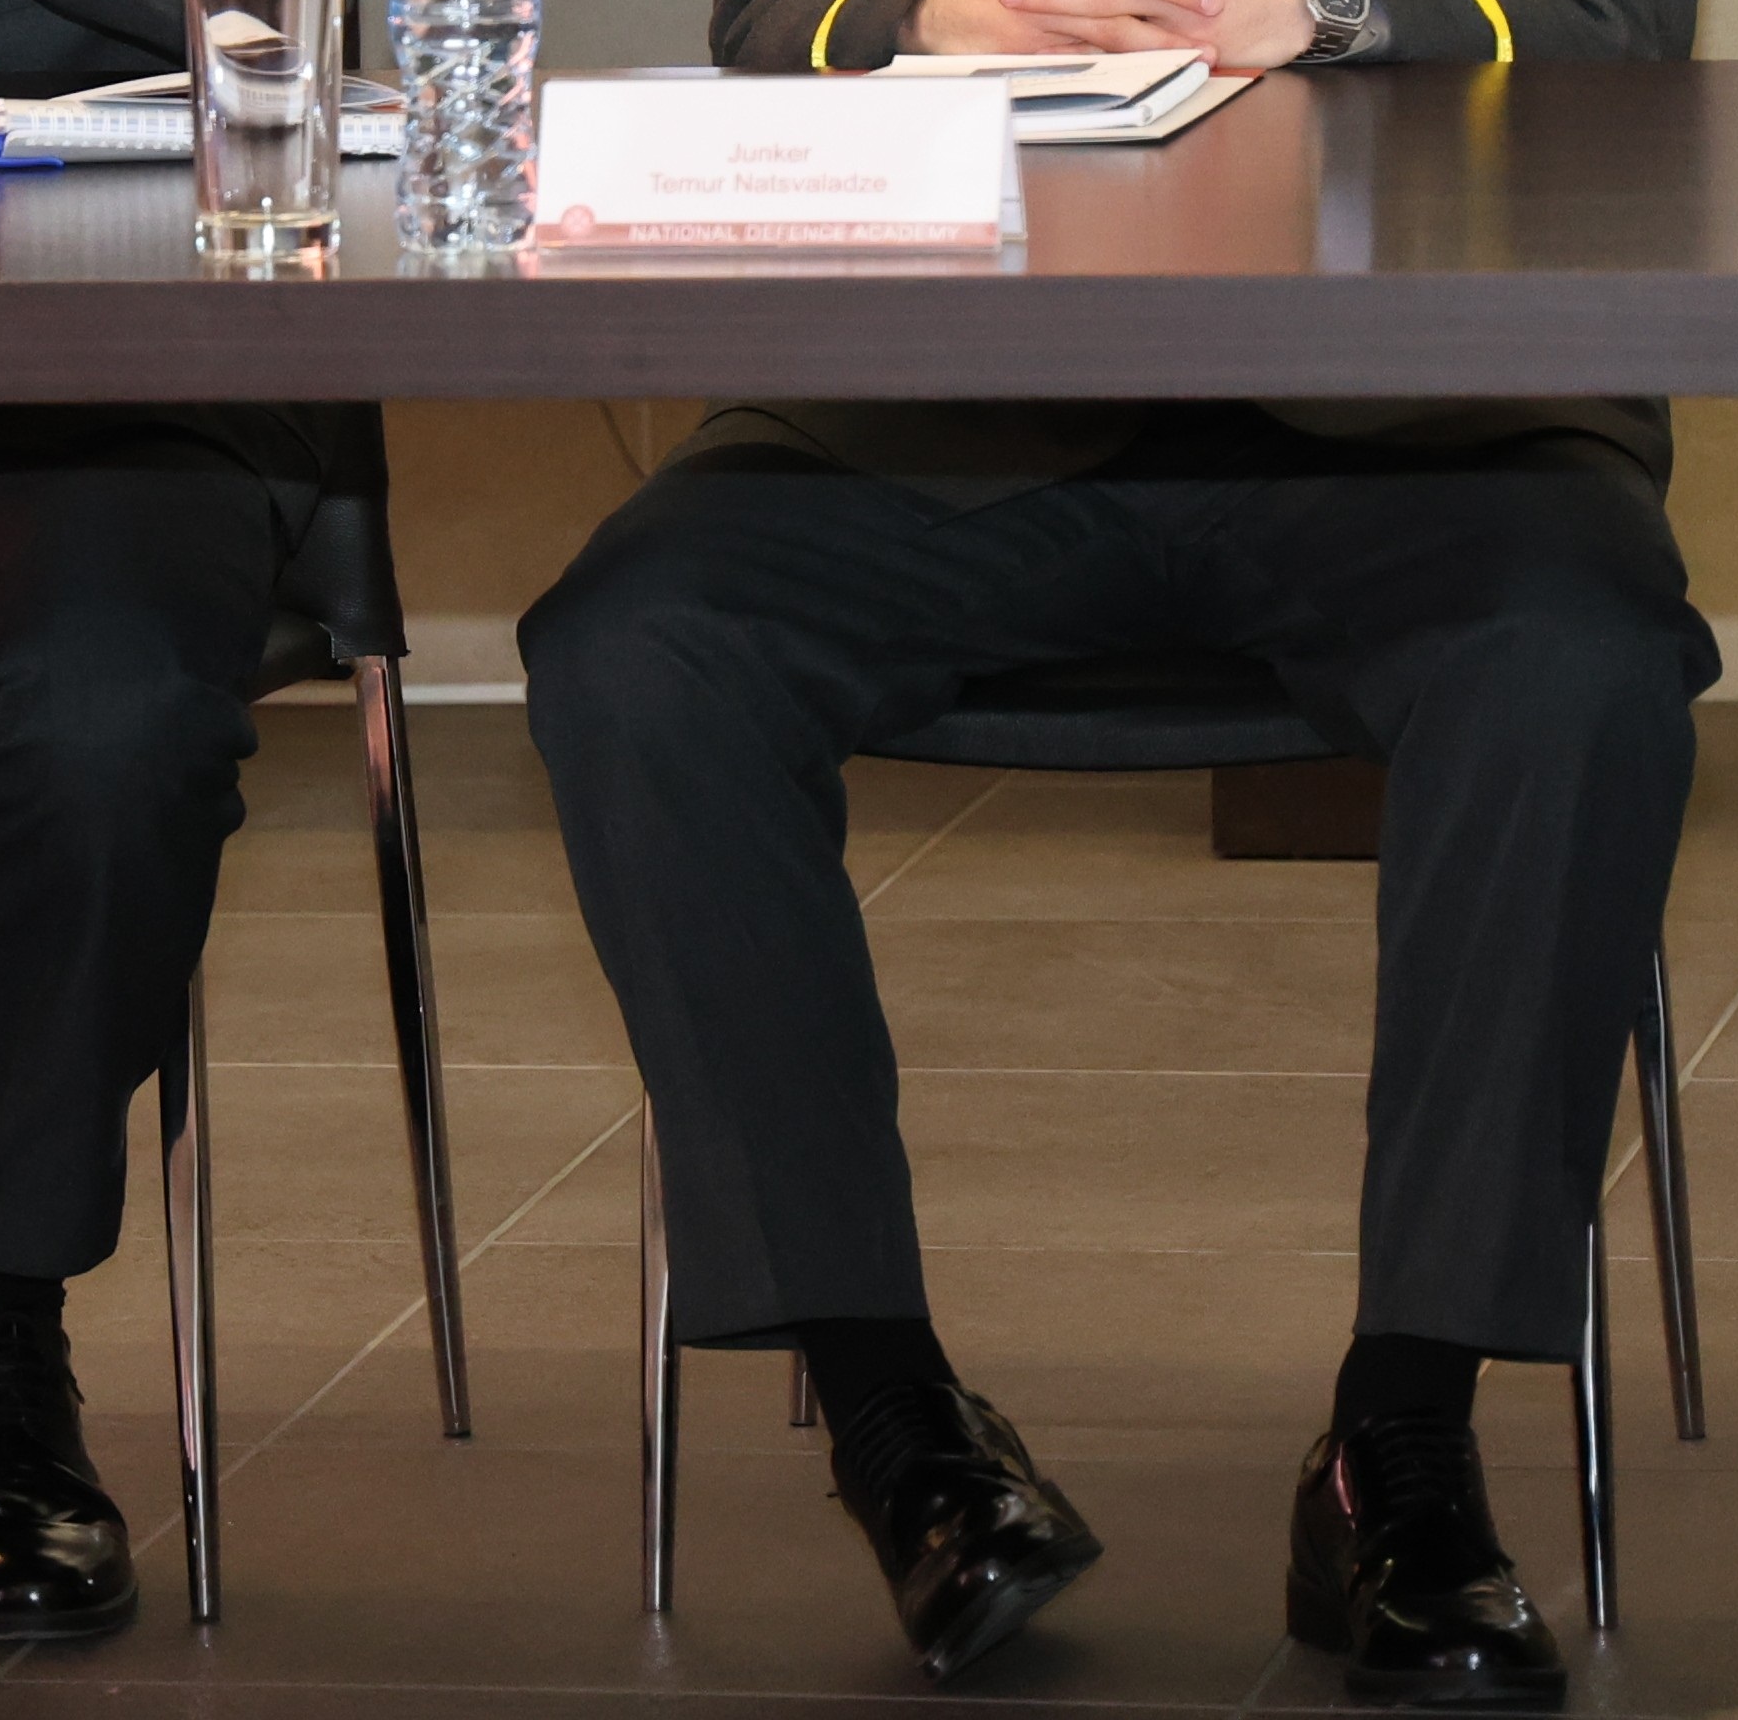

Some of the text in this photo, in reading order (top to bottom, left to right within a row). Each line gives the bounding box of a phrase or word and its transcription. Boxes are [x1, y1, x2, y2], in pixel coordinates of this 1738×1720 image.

[727, 144, 812, 164] Junker
[650, 172, 889, 194] Temur Natsvaladze
[629, 223, 960, 242] NATIONAL DEFENCE ACADEMY
